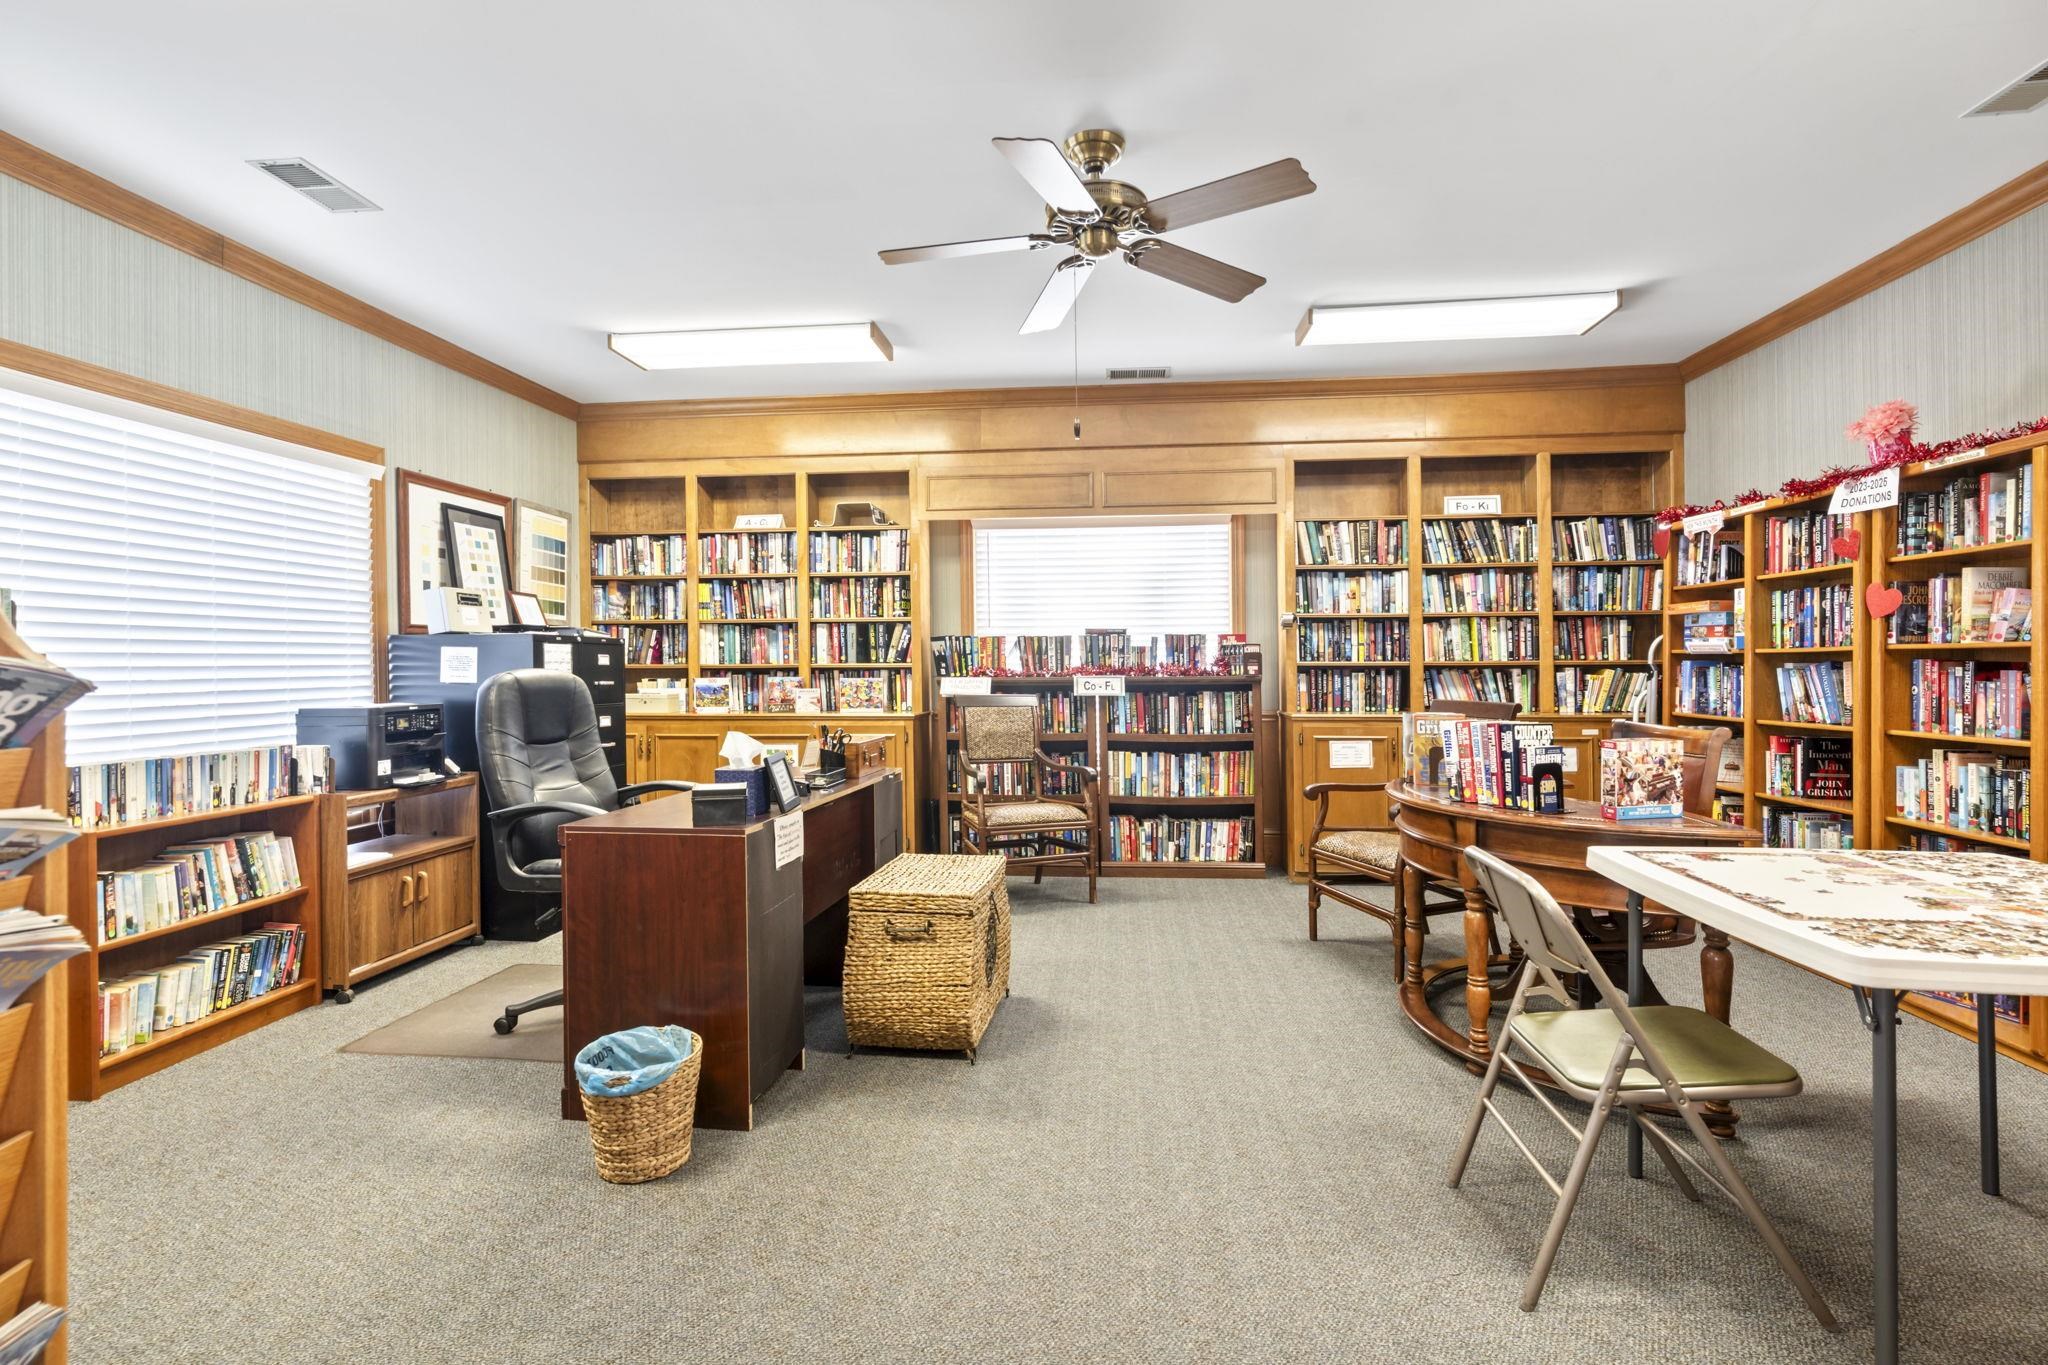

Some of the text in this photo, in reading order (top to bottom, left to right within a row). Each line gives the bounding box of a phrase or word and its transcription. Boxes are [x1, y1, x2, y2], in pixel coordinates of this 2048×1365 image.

[1849, 476, 1888, 494] 2023-2025
[1840, 490, 1893, 508] DONATIONS
[1987, 572, 2014, 581] DEBBIE
[1823, 676, 1831, 698] FOLLETT
[1443, 730, 1453, 758] Griffin
[1820, 740, 1841, 751] The
[1535, 753, 1562, 764] GRIFFIN
[1808, 749, 1852, 760] Innocent
[1817, 760, 1844, 771] Man
[1505, 772, 1513, 792] GRIFFIN
[1816, 780, 1843, 788] JOHN
[1807, 788, 1852, 798] GRISHAM
[238, 953, 246, 973] WOODS
[243, 952, 251, 972] STUART
